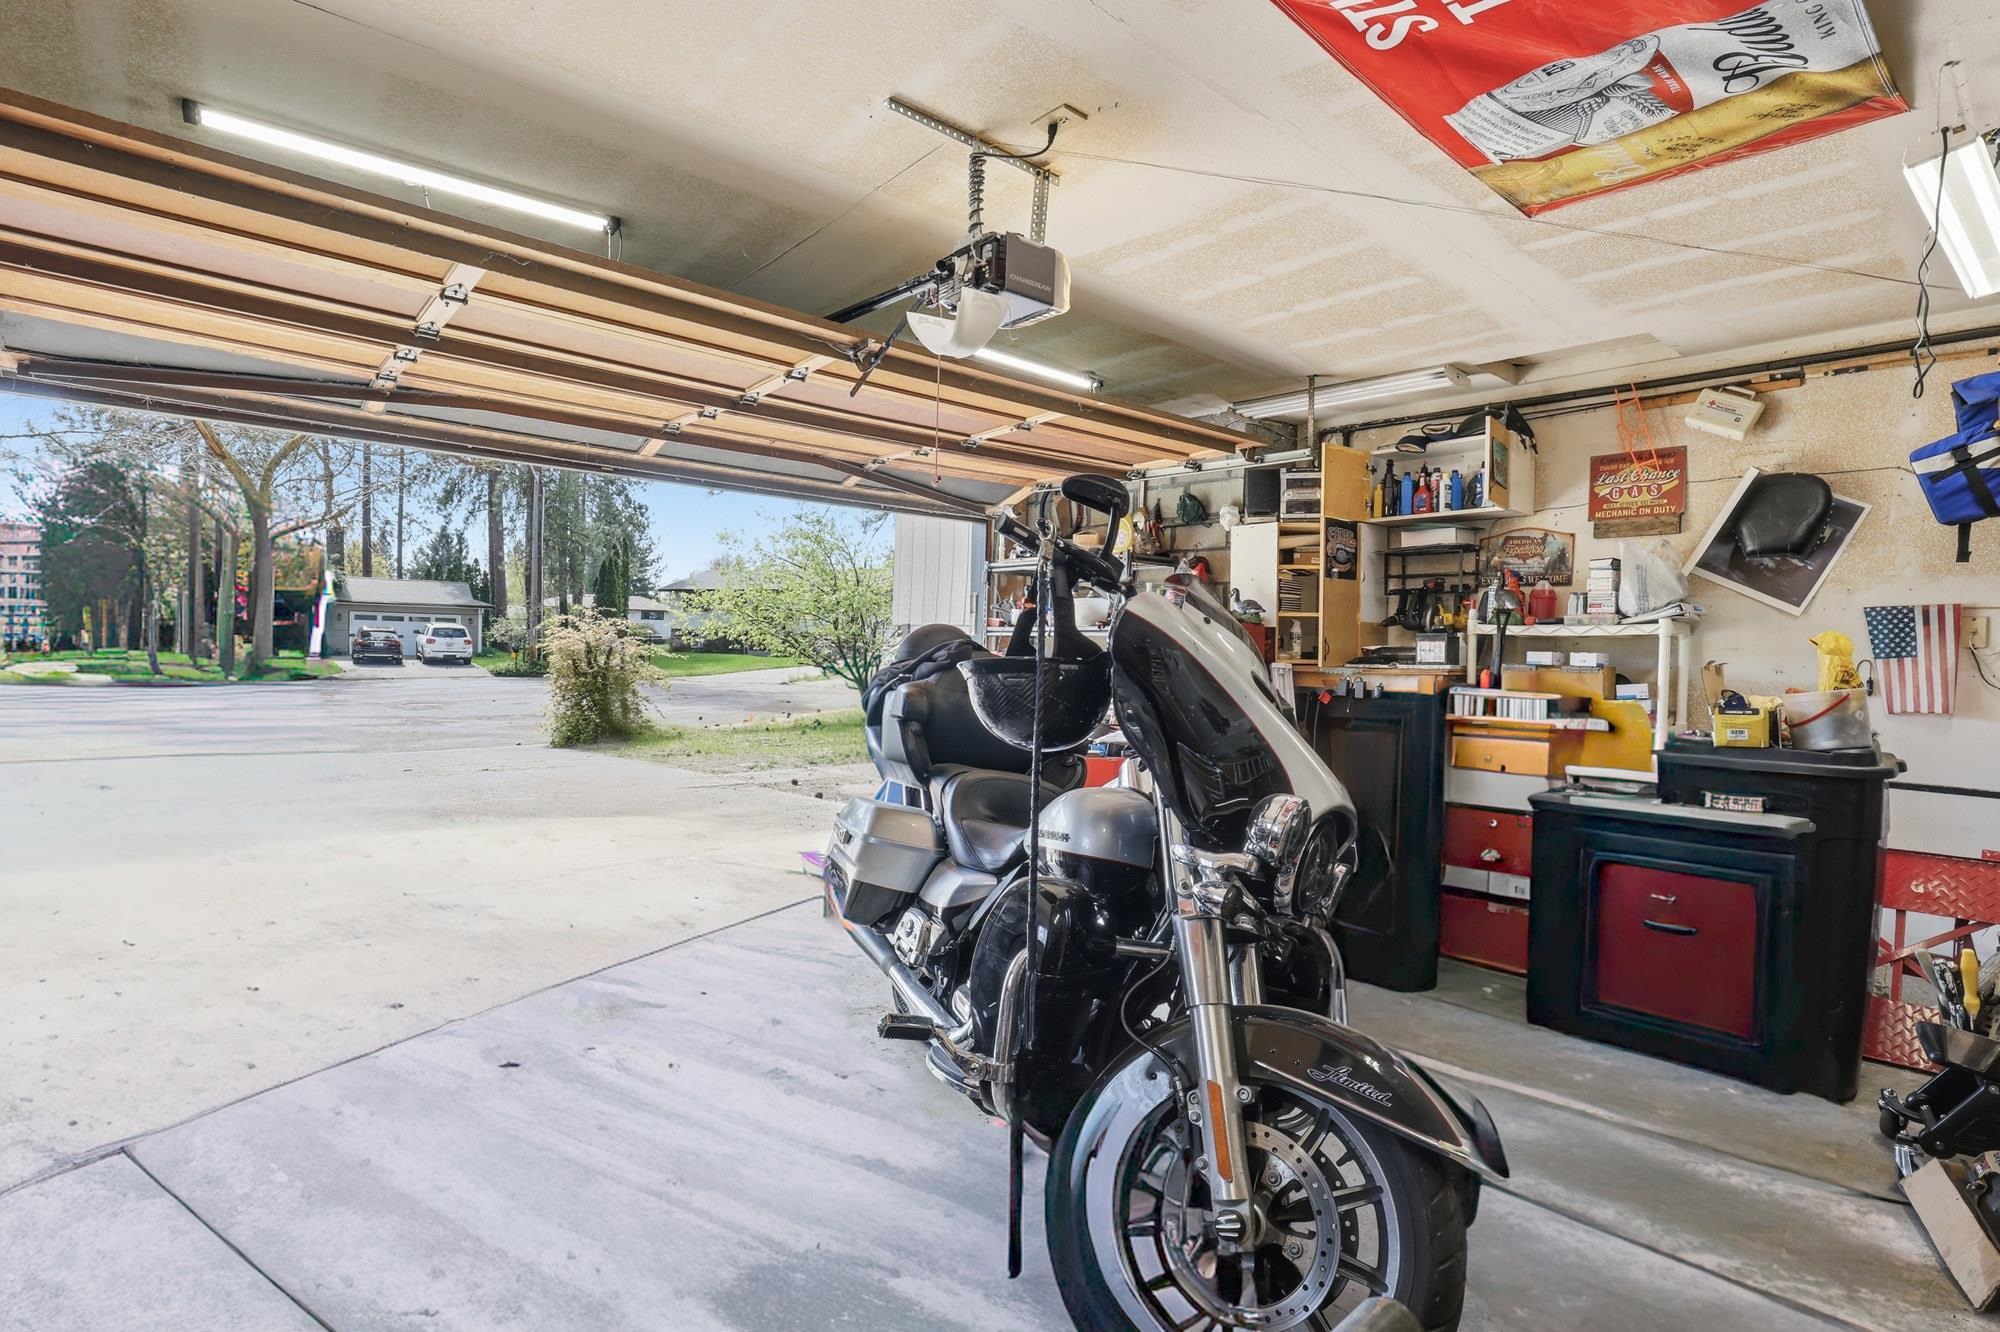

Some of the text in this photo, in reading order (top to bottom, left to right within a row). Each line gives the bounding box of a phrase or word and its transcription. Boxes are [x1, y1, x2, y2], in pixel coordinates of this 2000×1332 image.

[1328, 0, 1440, 50] ST
[1805, 3, 1837, 40] KING
[1593, 467, 1681, 486] Last Chance
[1611, 483, 1659, 499] GAS
[1595, 505, 1676, 518] MECHANIC ON DUTY
[1306, 1064, 1393, 1107] Limited
